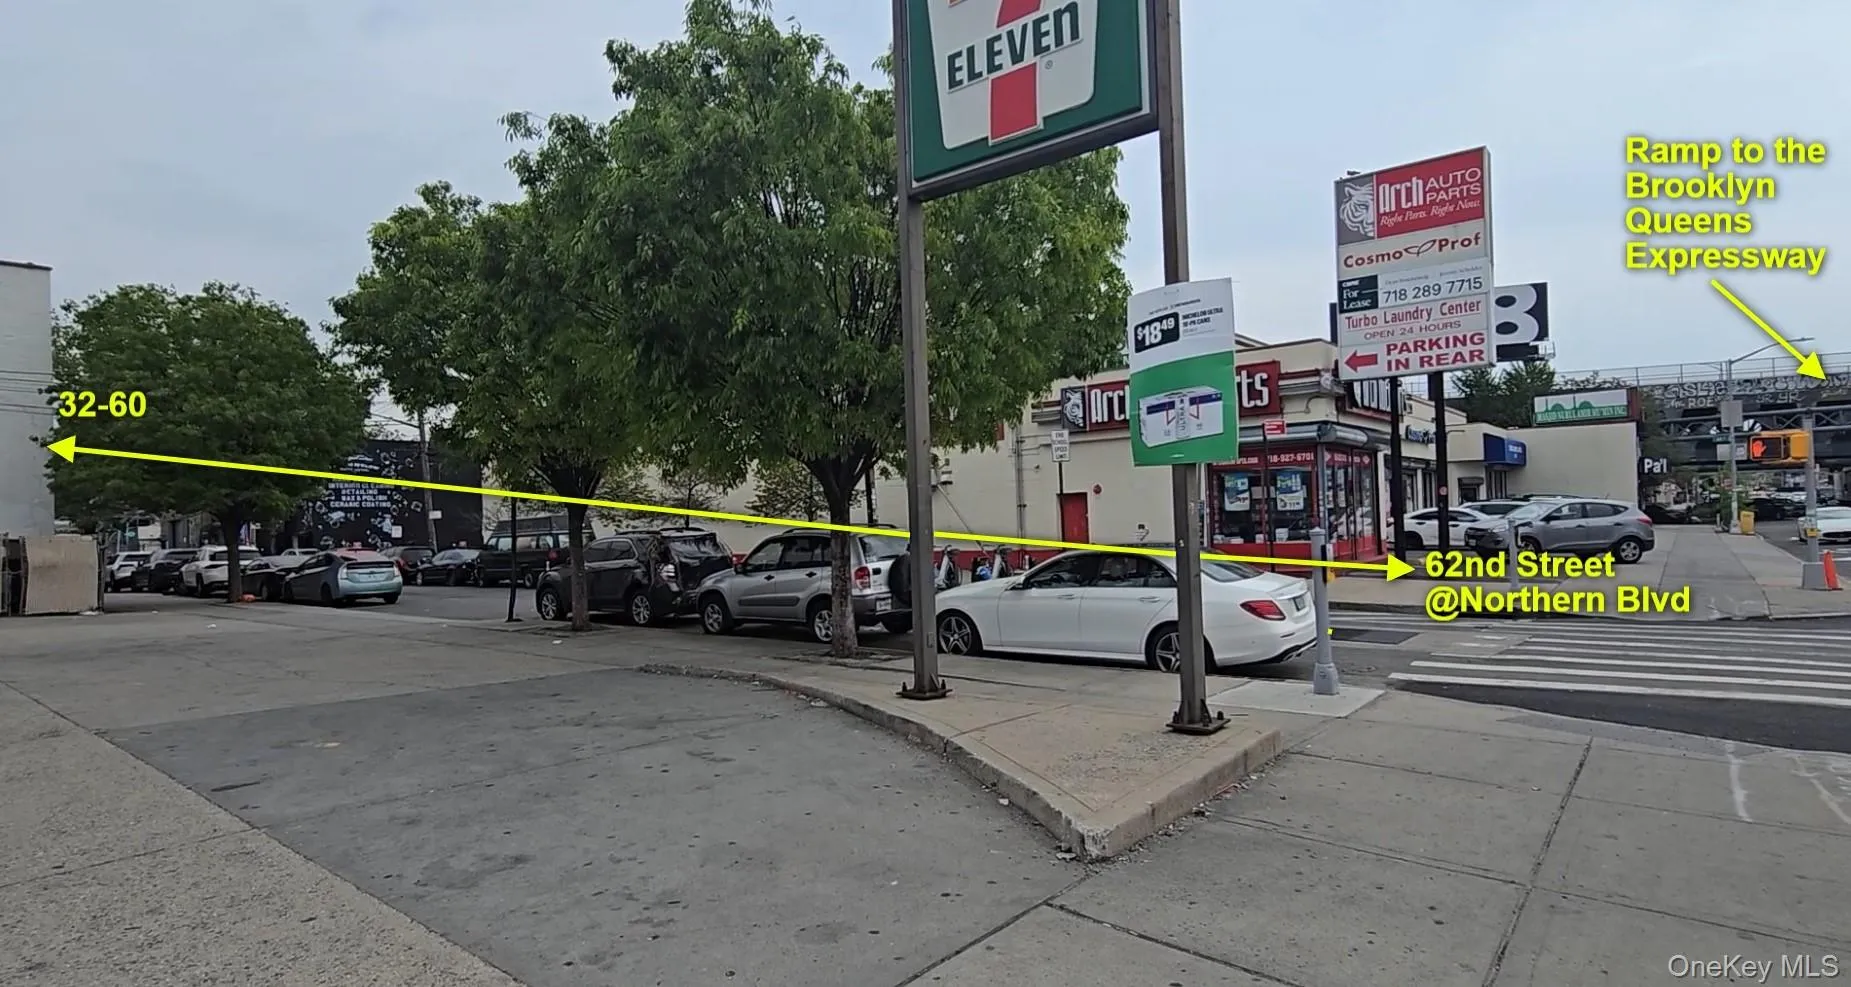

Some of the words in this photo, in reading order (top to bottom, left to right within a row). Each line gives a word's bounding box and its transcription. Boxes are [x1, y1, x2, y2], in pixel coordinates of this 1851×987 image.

[1425, 167, 1481, 191] AUTO
[1379, 175, 1424, 214] Arch
[1426, 182, 1481, 204] PARTS
[1380, 214, 1403, 227] Right
[1430, 203, 1455, 217] Right
[1343, 250, 1404, 268] Cosmo
[1438, 232, 1481, 252] Prof
[1343, 289, 1359, 299] For
[1383, 288, 1408, 303] 718
[1412, 283, 1441, 299] 289
[1446, 276, 1483, 293] 7715
[1343, 299, 1372, 309] Lease
[1345, 314, 1378, 329] Turbo
[1383, 306, 1433, 324] Laundry
[1440, 300, 1481, 316] Center
[1364, 330, 1395, 340] OPEN
[1400, 326, 1414, 337] 24
[1420, 320, 1461, 333] HOURS
[1386, 332, 1485, 356] PARKING
[1387, 357, 1410, 372] IN
[1420, 349, 1485, 368] REAR
